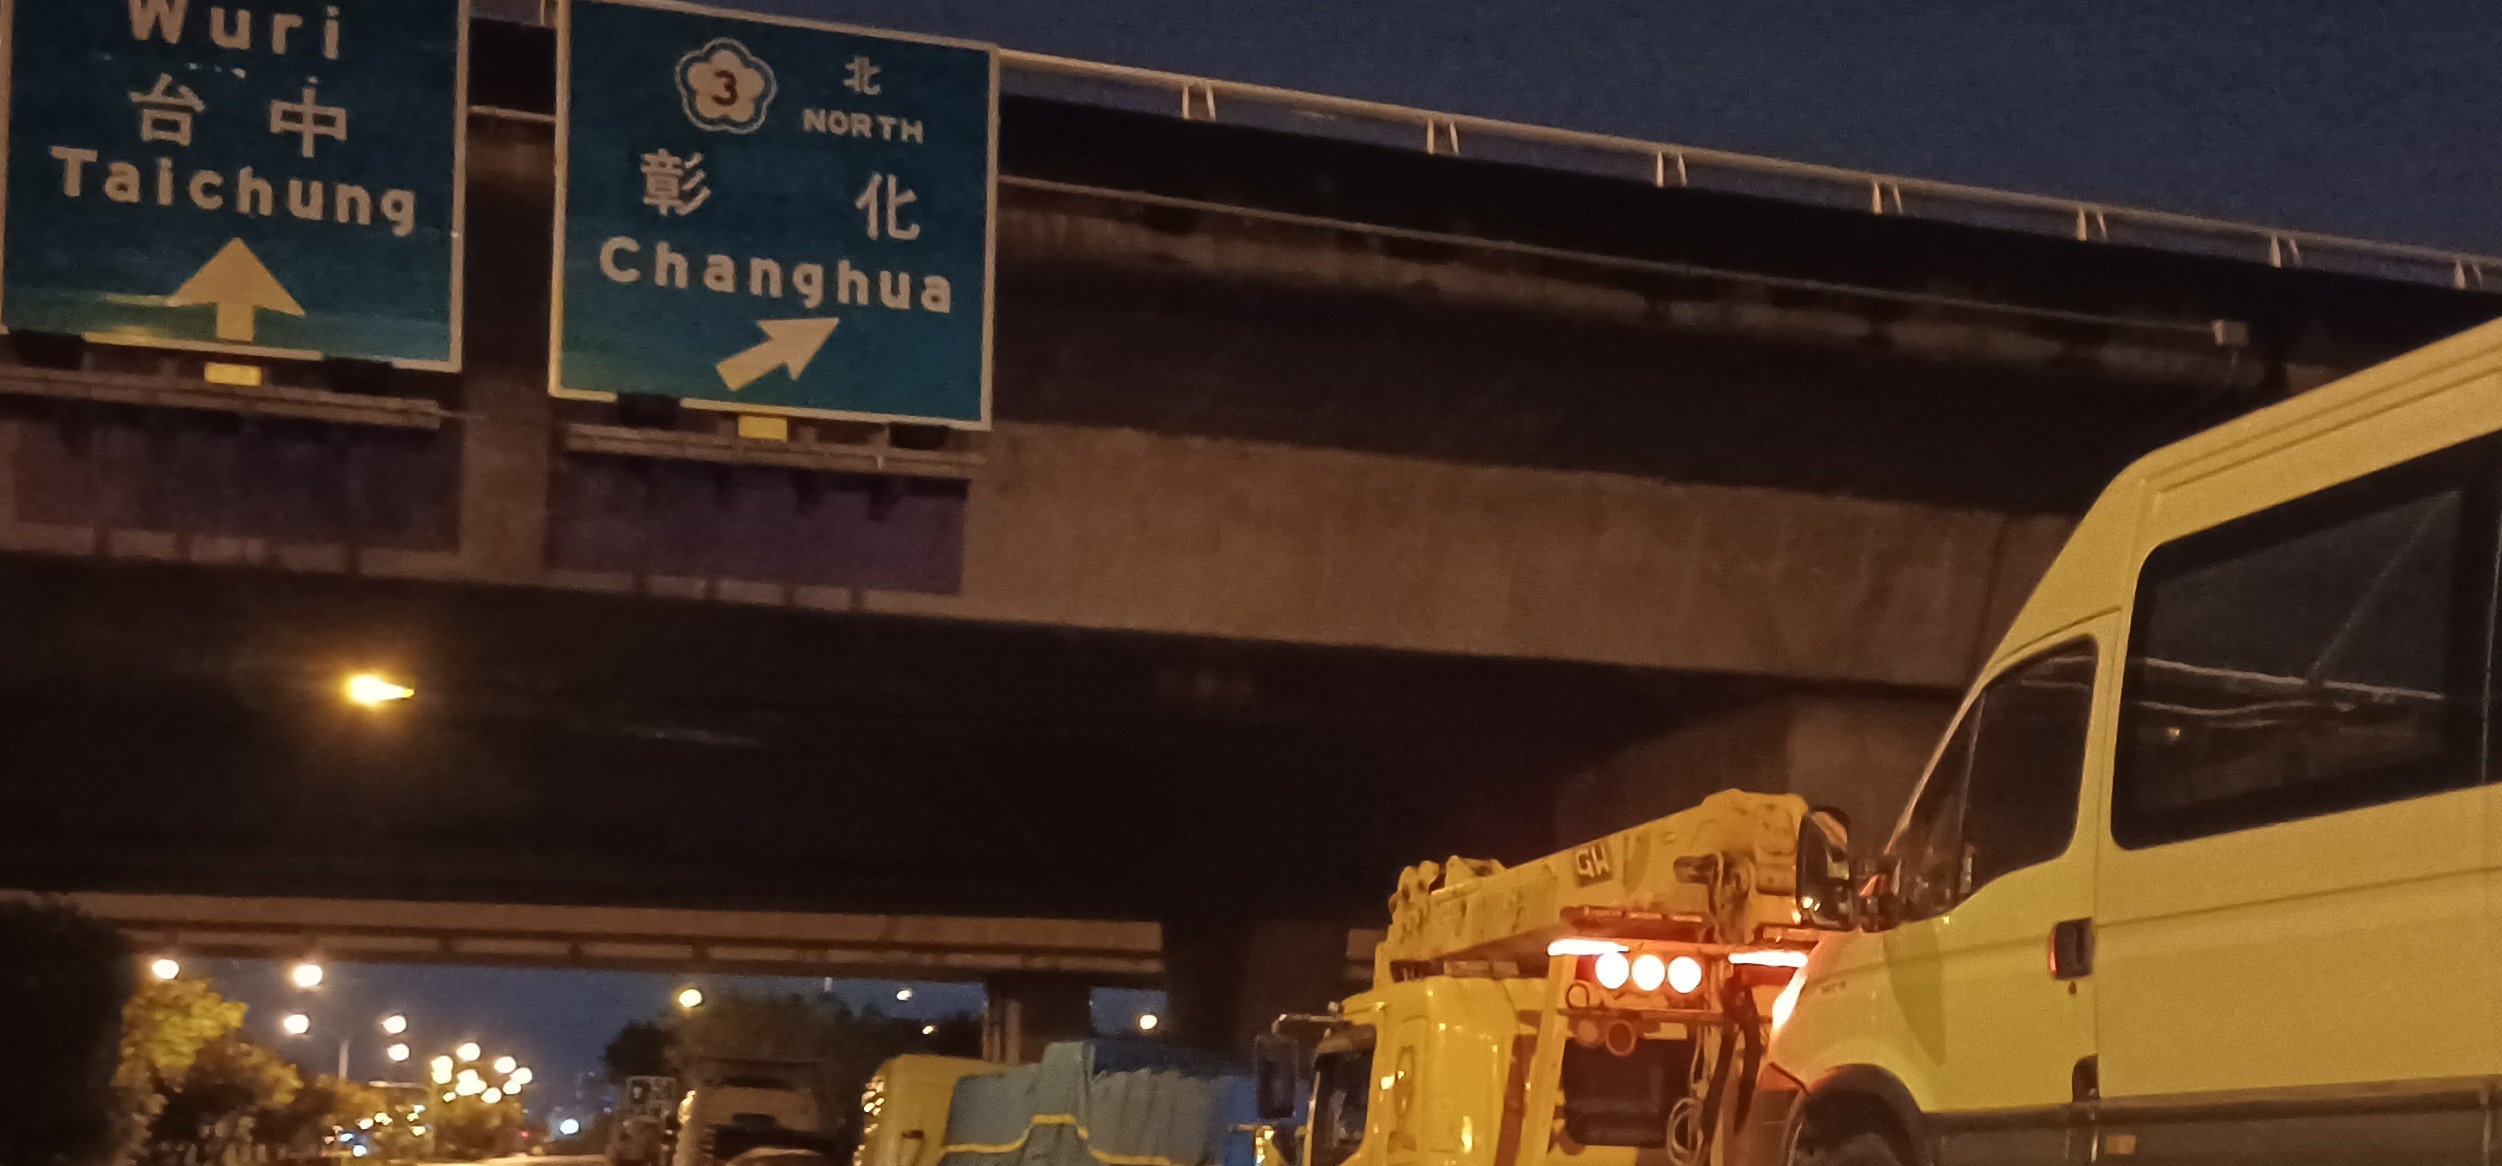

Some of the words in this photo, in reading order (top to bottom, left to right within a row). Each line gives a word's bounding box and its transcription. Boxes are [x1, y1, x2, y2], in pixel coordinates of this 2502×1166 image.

[128, 0, 340, 60] Wuri
[713, 69, 738, 107] 3
[843, 55, 882, 96] 北
[128, 72, 348, 158] 台中
[802, 107, 924, 144] NORTH
[50, 145, 416, 237] Taichung
[640, 147, 921, 241] 彰化
[599, 235, 951, 314] Changhua
